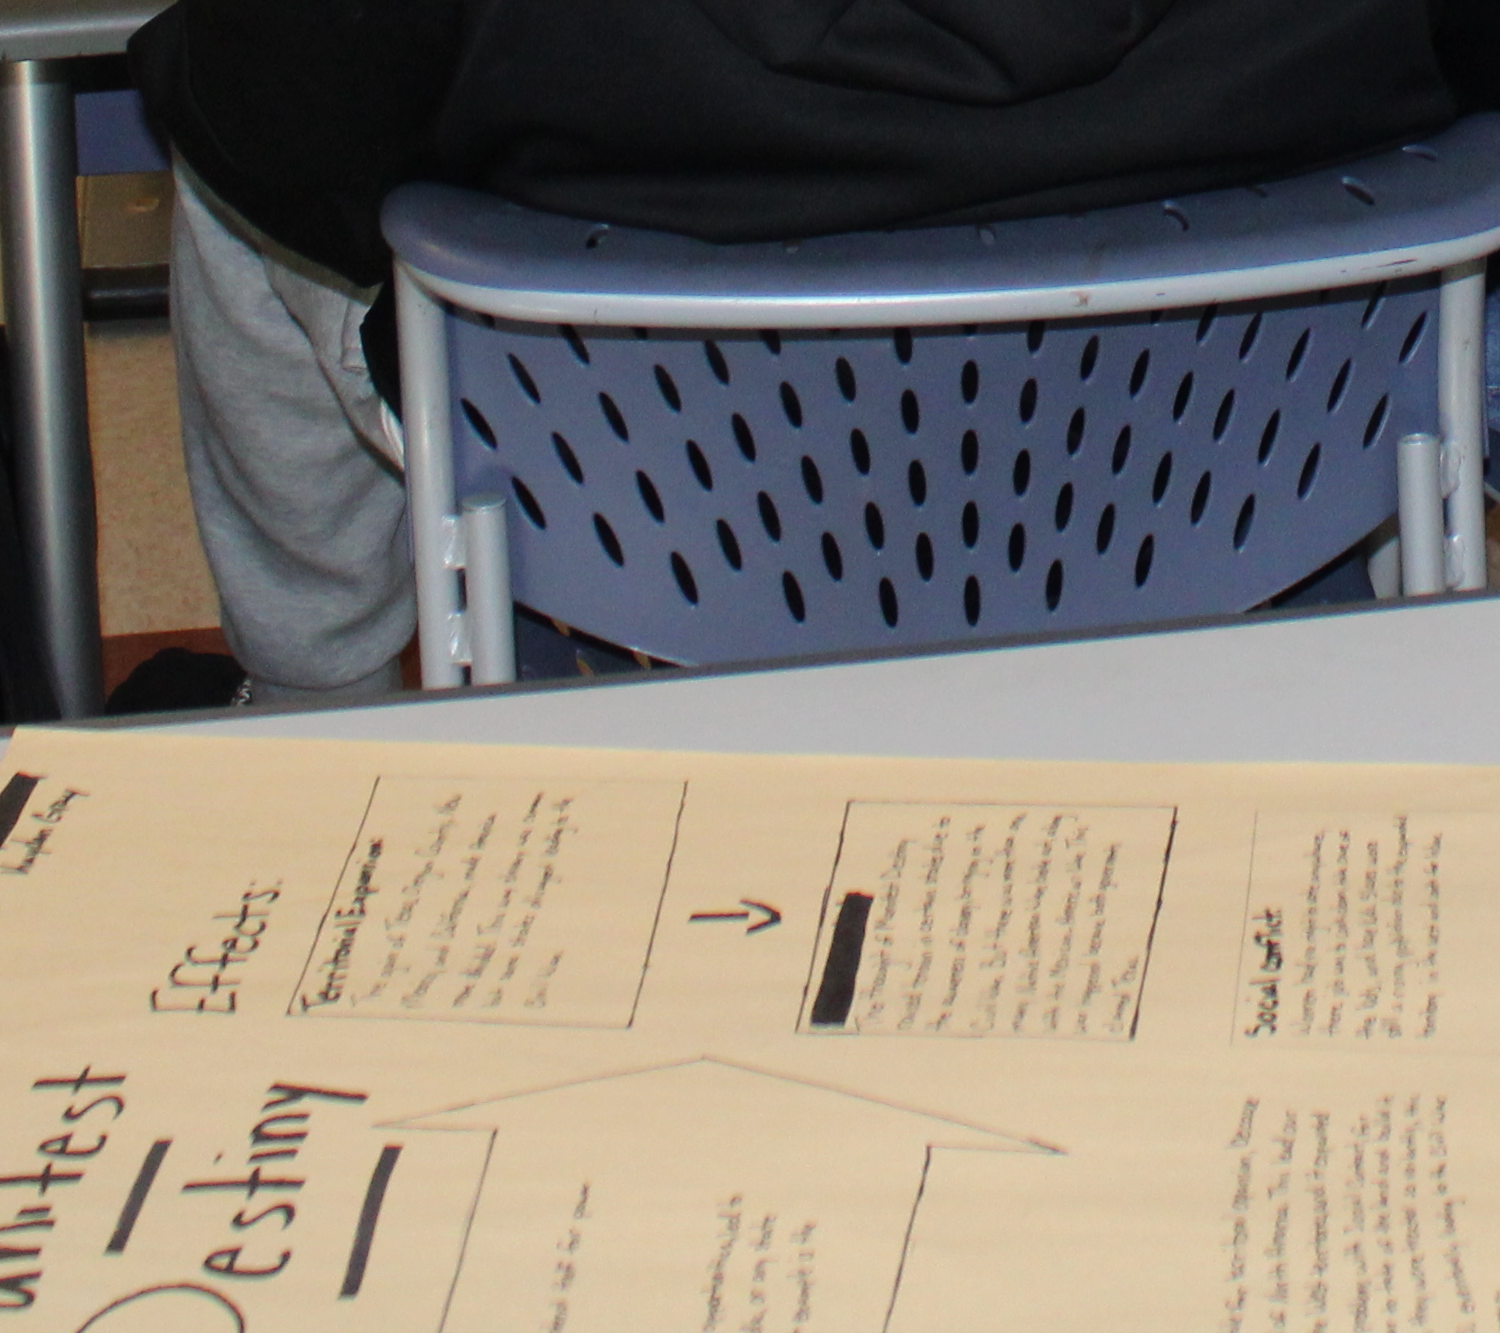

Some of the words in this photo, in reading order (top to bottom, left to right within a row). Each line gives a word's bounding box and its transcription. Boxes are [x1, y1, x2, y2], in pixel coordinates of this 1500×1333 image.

[874, 881, 901, 930] Manifest
[151, 879, 284, 1014] Effects:
[300, 922, 358, 1014] Territorial
[858, 948, 913, 1001] thought
[1243, 976, 1281, 1038] Social
